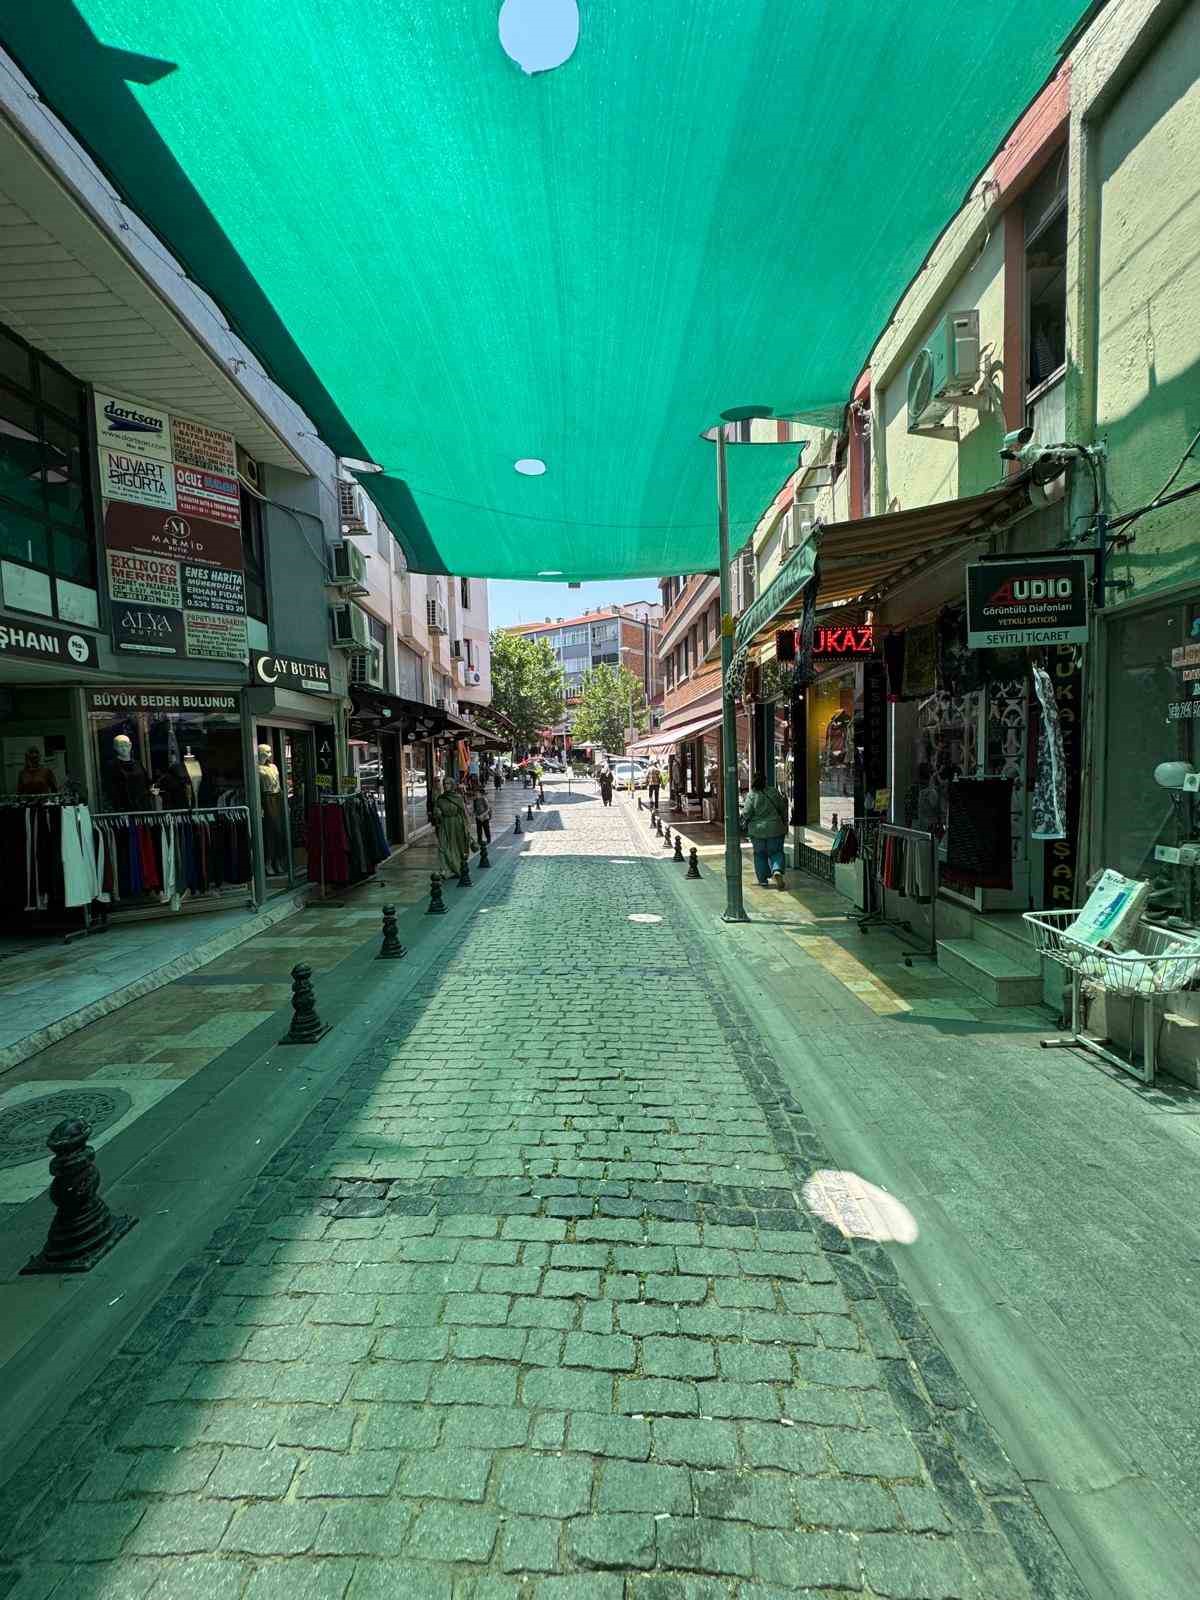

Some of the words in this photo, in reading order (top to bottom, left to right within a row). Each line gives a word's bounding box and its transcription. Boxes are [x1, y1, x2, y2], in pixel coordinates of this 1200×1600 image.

[104, 401, 162, 428] dartsan
[109, 453, 165, 479] NOVART
[112, 568, 177, 586] MERMER
[185, 566, 208, 580] ENES
[983, 604, 1027, 616] Görüntülü
[1029, 602, 1072, 614] Diafonları
[93, 692, 137, 706] BÜYÜK
[141, 695, 180, 707] BEDEN
[183, 696, 235, 708] BULUNUR
